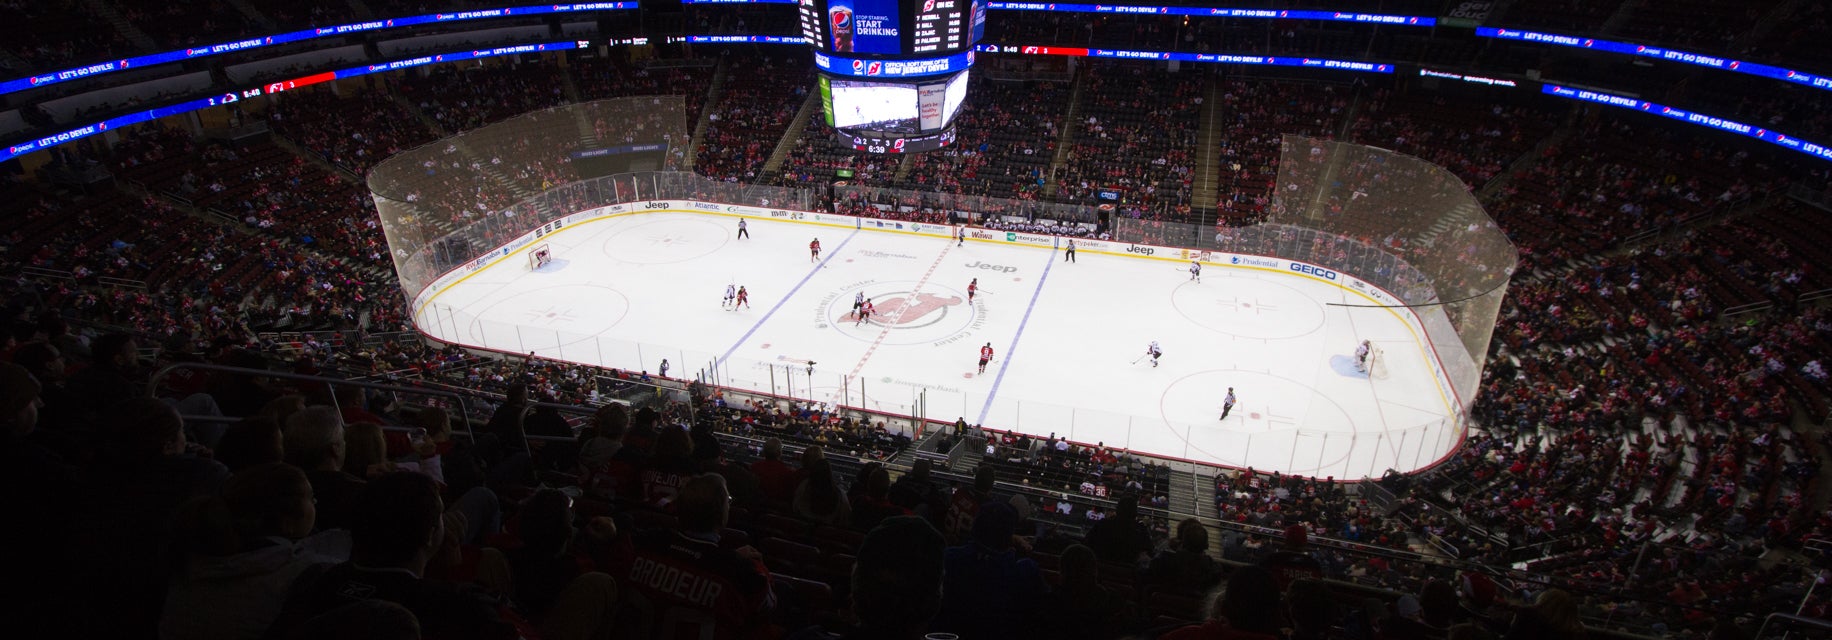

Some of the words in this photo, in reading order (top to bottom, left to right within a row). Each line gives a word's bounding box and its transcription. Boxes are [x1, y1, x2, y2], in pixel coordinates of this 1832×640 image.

[458, 11, 472, 19] LET'S
[857, 28, 898, 36] DRINKING
[240, 39, 261, 47] DEVILS!
[1524, 32, 1542, 40] LET'S
[1554, 36, 1579, 45] DEVILS!
[413, 57, 431, 65] DEVILS!
[1665, 50, 1682, 60] LET'S
[1696, 56, 1723, 67] DEVILS!
[927, 63, 949, 72] DEVILS
[1351, 62, 1373, 70] DEVILS!
[59, 70, 77, 79] LET'S
[78, 68, 88, 76] GO
[89, 63, 114, 73] DEVILS!
[39, 75, 54, 83] pepsi
[1579, 91, 1597, 100] LET'S
[1610, 97, 1637, 107] DEVILS!
[1689, 113, 1708, 123] LET'S
[1709, 118, 1721, 126] GO
[1721, 121, 1751, 133] DEVILS!
[39, 137, 58, 147] LET'S
[58, 133, 69, 141] GO
[70, 126, 94, 138] DEVILS!
[18, 143, 35, 152] pepsi
[1803, 143, 1822, 154] LET'S
[645, 201, 669, 209] Jeep
[695, 202, 720, 210] Atlantic
[971, 230, 992, 239] Wawa
[510, 236, 533, 251] Prudential
[1126, 244, 1154, 256] Jeep
[965, 261, 1018, 273] Jeep
[1243, 258, 1278, 267] Prudential
[1290, 262, 1336, 280] GEICO
[1095, 488, 1106, 497] 30
[628, 557, 723, 609] BRODEUR
